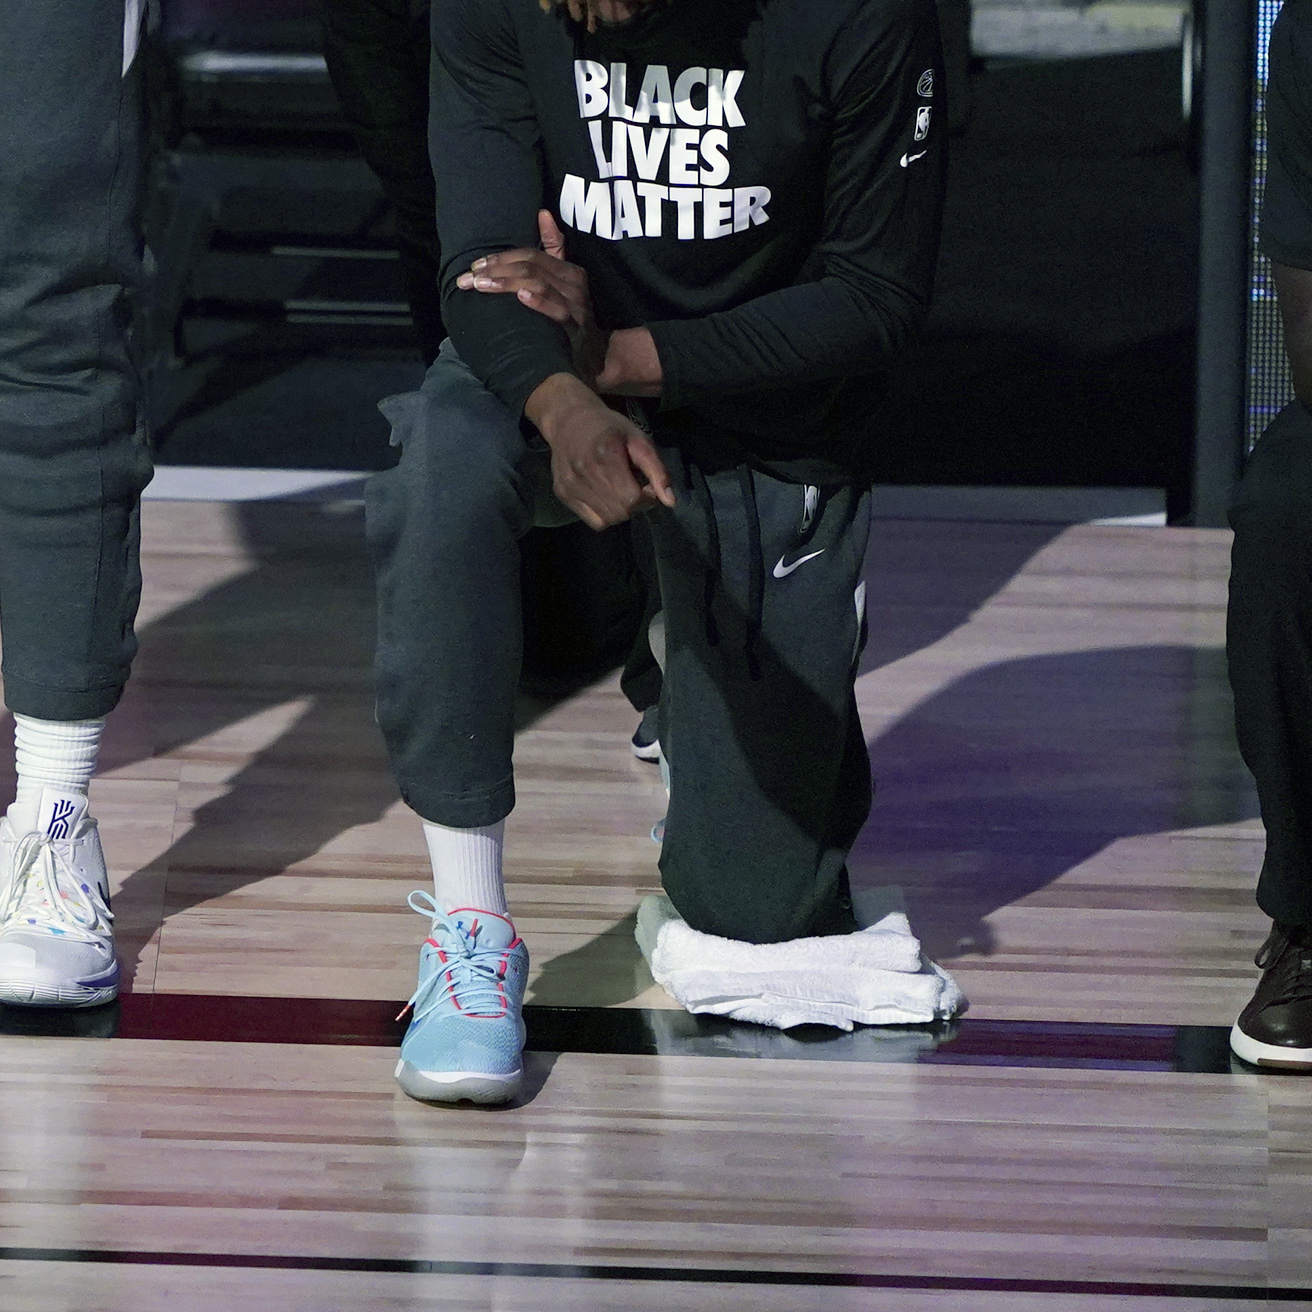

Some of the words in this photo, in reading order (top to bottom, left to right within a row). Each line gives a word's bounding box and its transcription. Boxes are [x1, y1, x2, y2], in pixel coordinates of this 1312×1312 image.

[574, 59, 747, 128] BLACK
[587, 119, 731, 187] LIVES
[559, 173, 772, 241] MATTER
